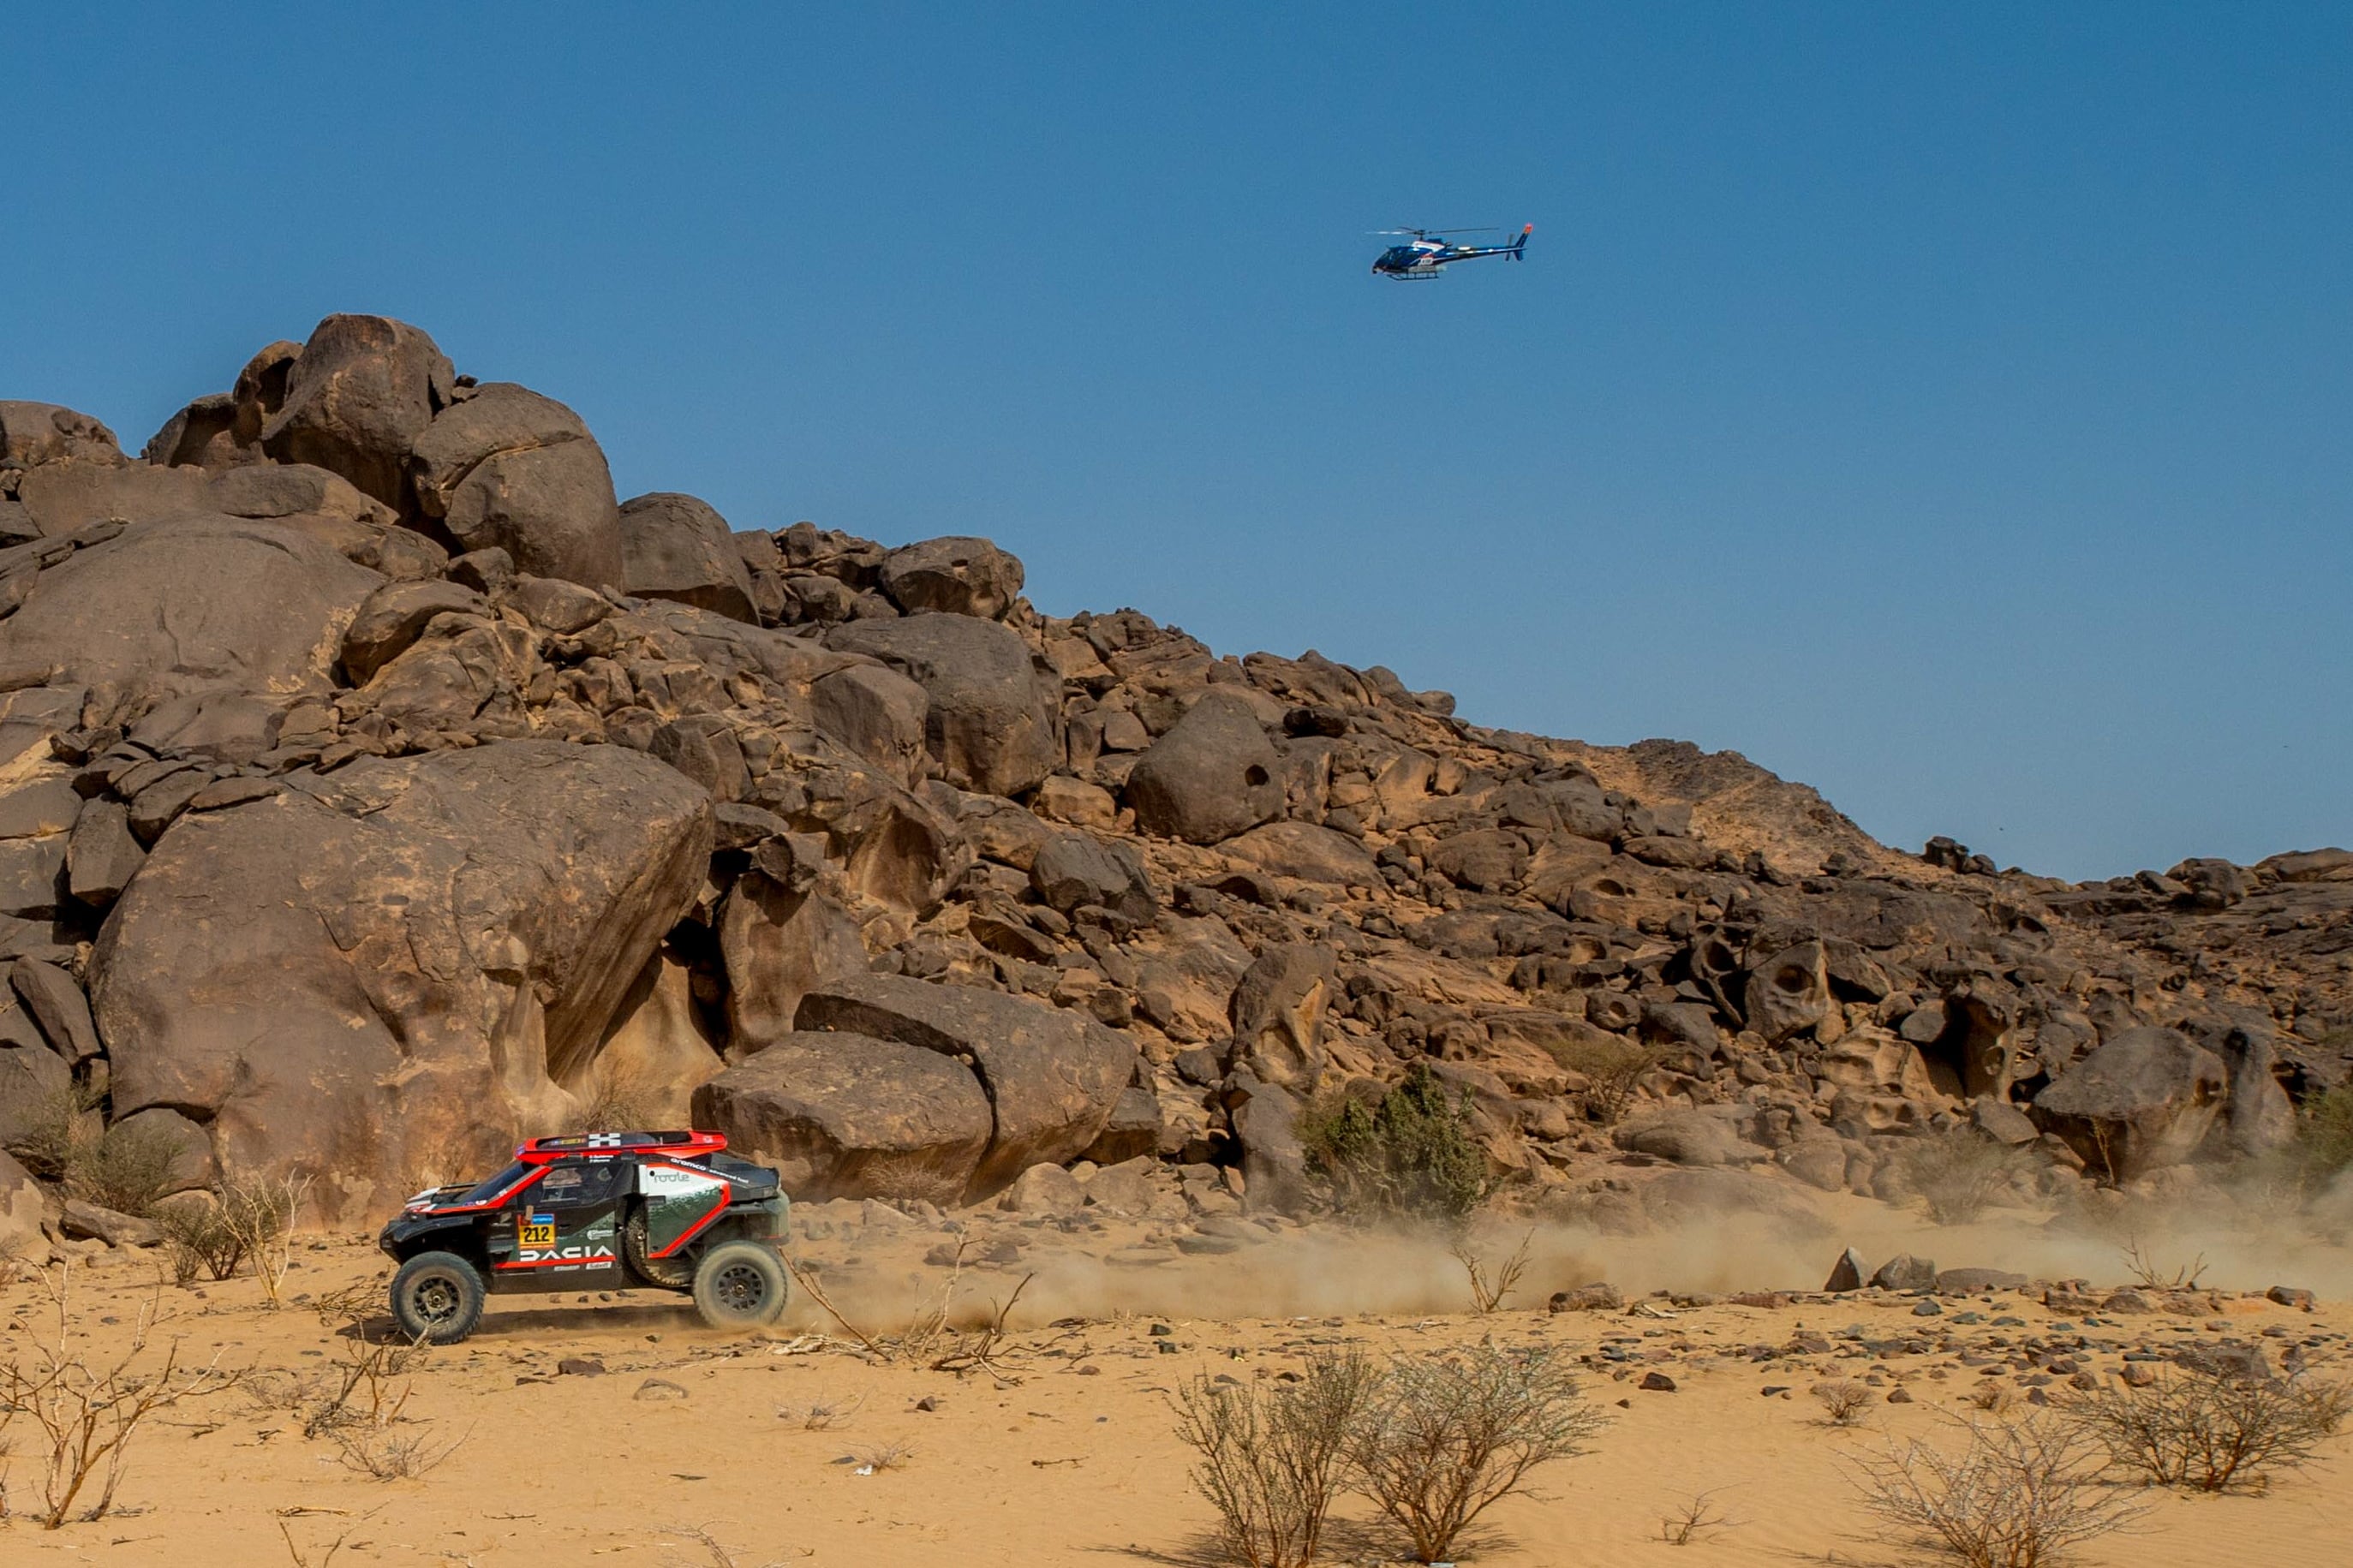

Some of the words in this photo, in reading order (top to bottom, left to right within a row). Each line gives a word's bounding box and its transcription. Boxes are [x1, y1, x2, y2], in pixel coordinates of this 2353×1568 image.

[671, 1158, 707, 1171] aramco
[523, 1226, 550, 1243] 212
[520, 1245, 615, 1261] DACIA
